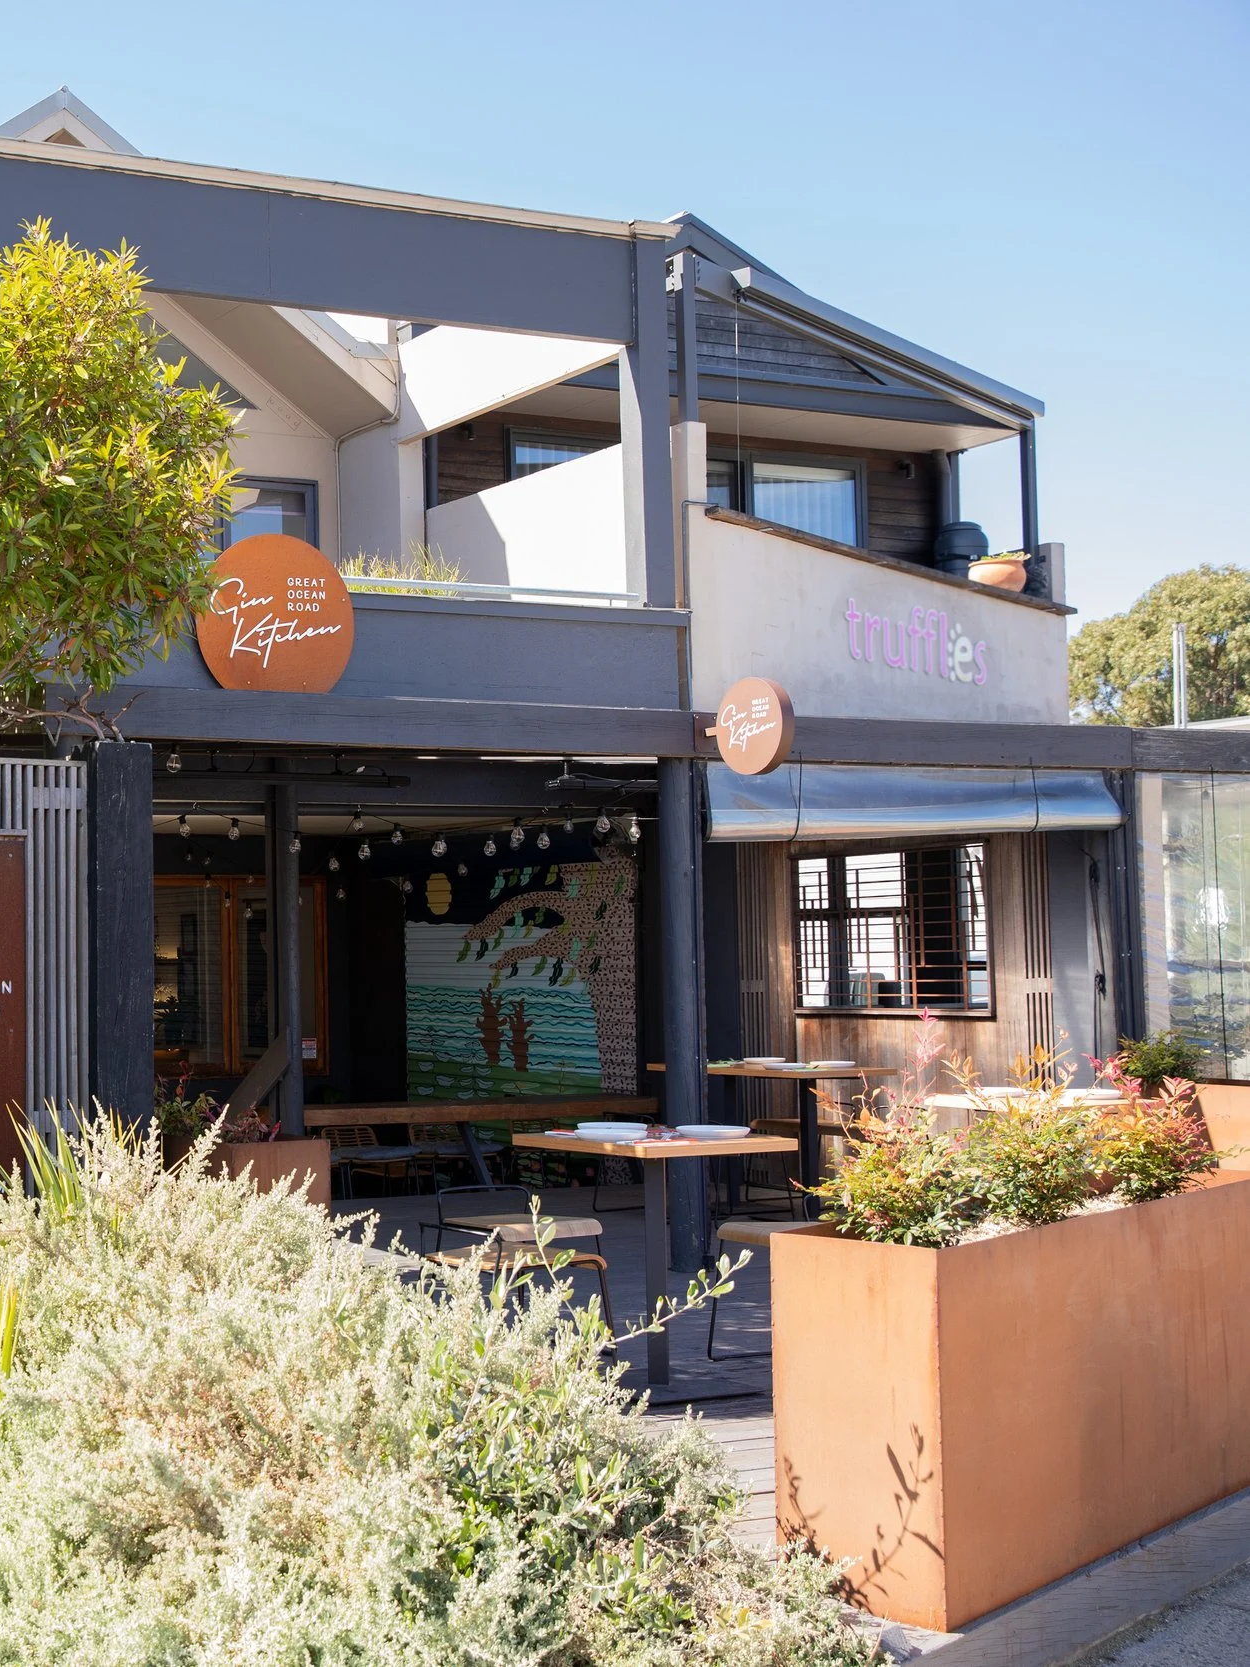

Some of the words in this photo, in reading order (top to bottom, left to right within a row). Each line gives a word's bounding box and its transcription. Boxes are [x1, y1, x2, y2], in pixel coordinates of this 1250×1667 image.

[287, 577, 326, 588] GREAT
[287, 590, 326, 600] OCEAN
[210, 577, 274, 625] Gin
[287, 602, 320, 612] ROAD
[229, 613, 342, 669] Kitchen
[846, 598, 987, 685] truffles
[720, 704, 747, 731] Gin
[729, 721, 776, 752] Kitchen
